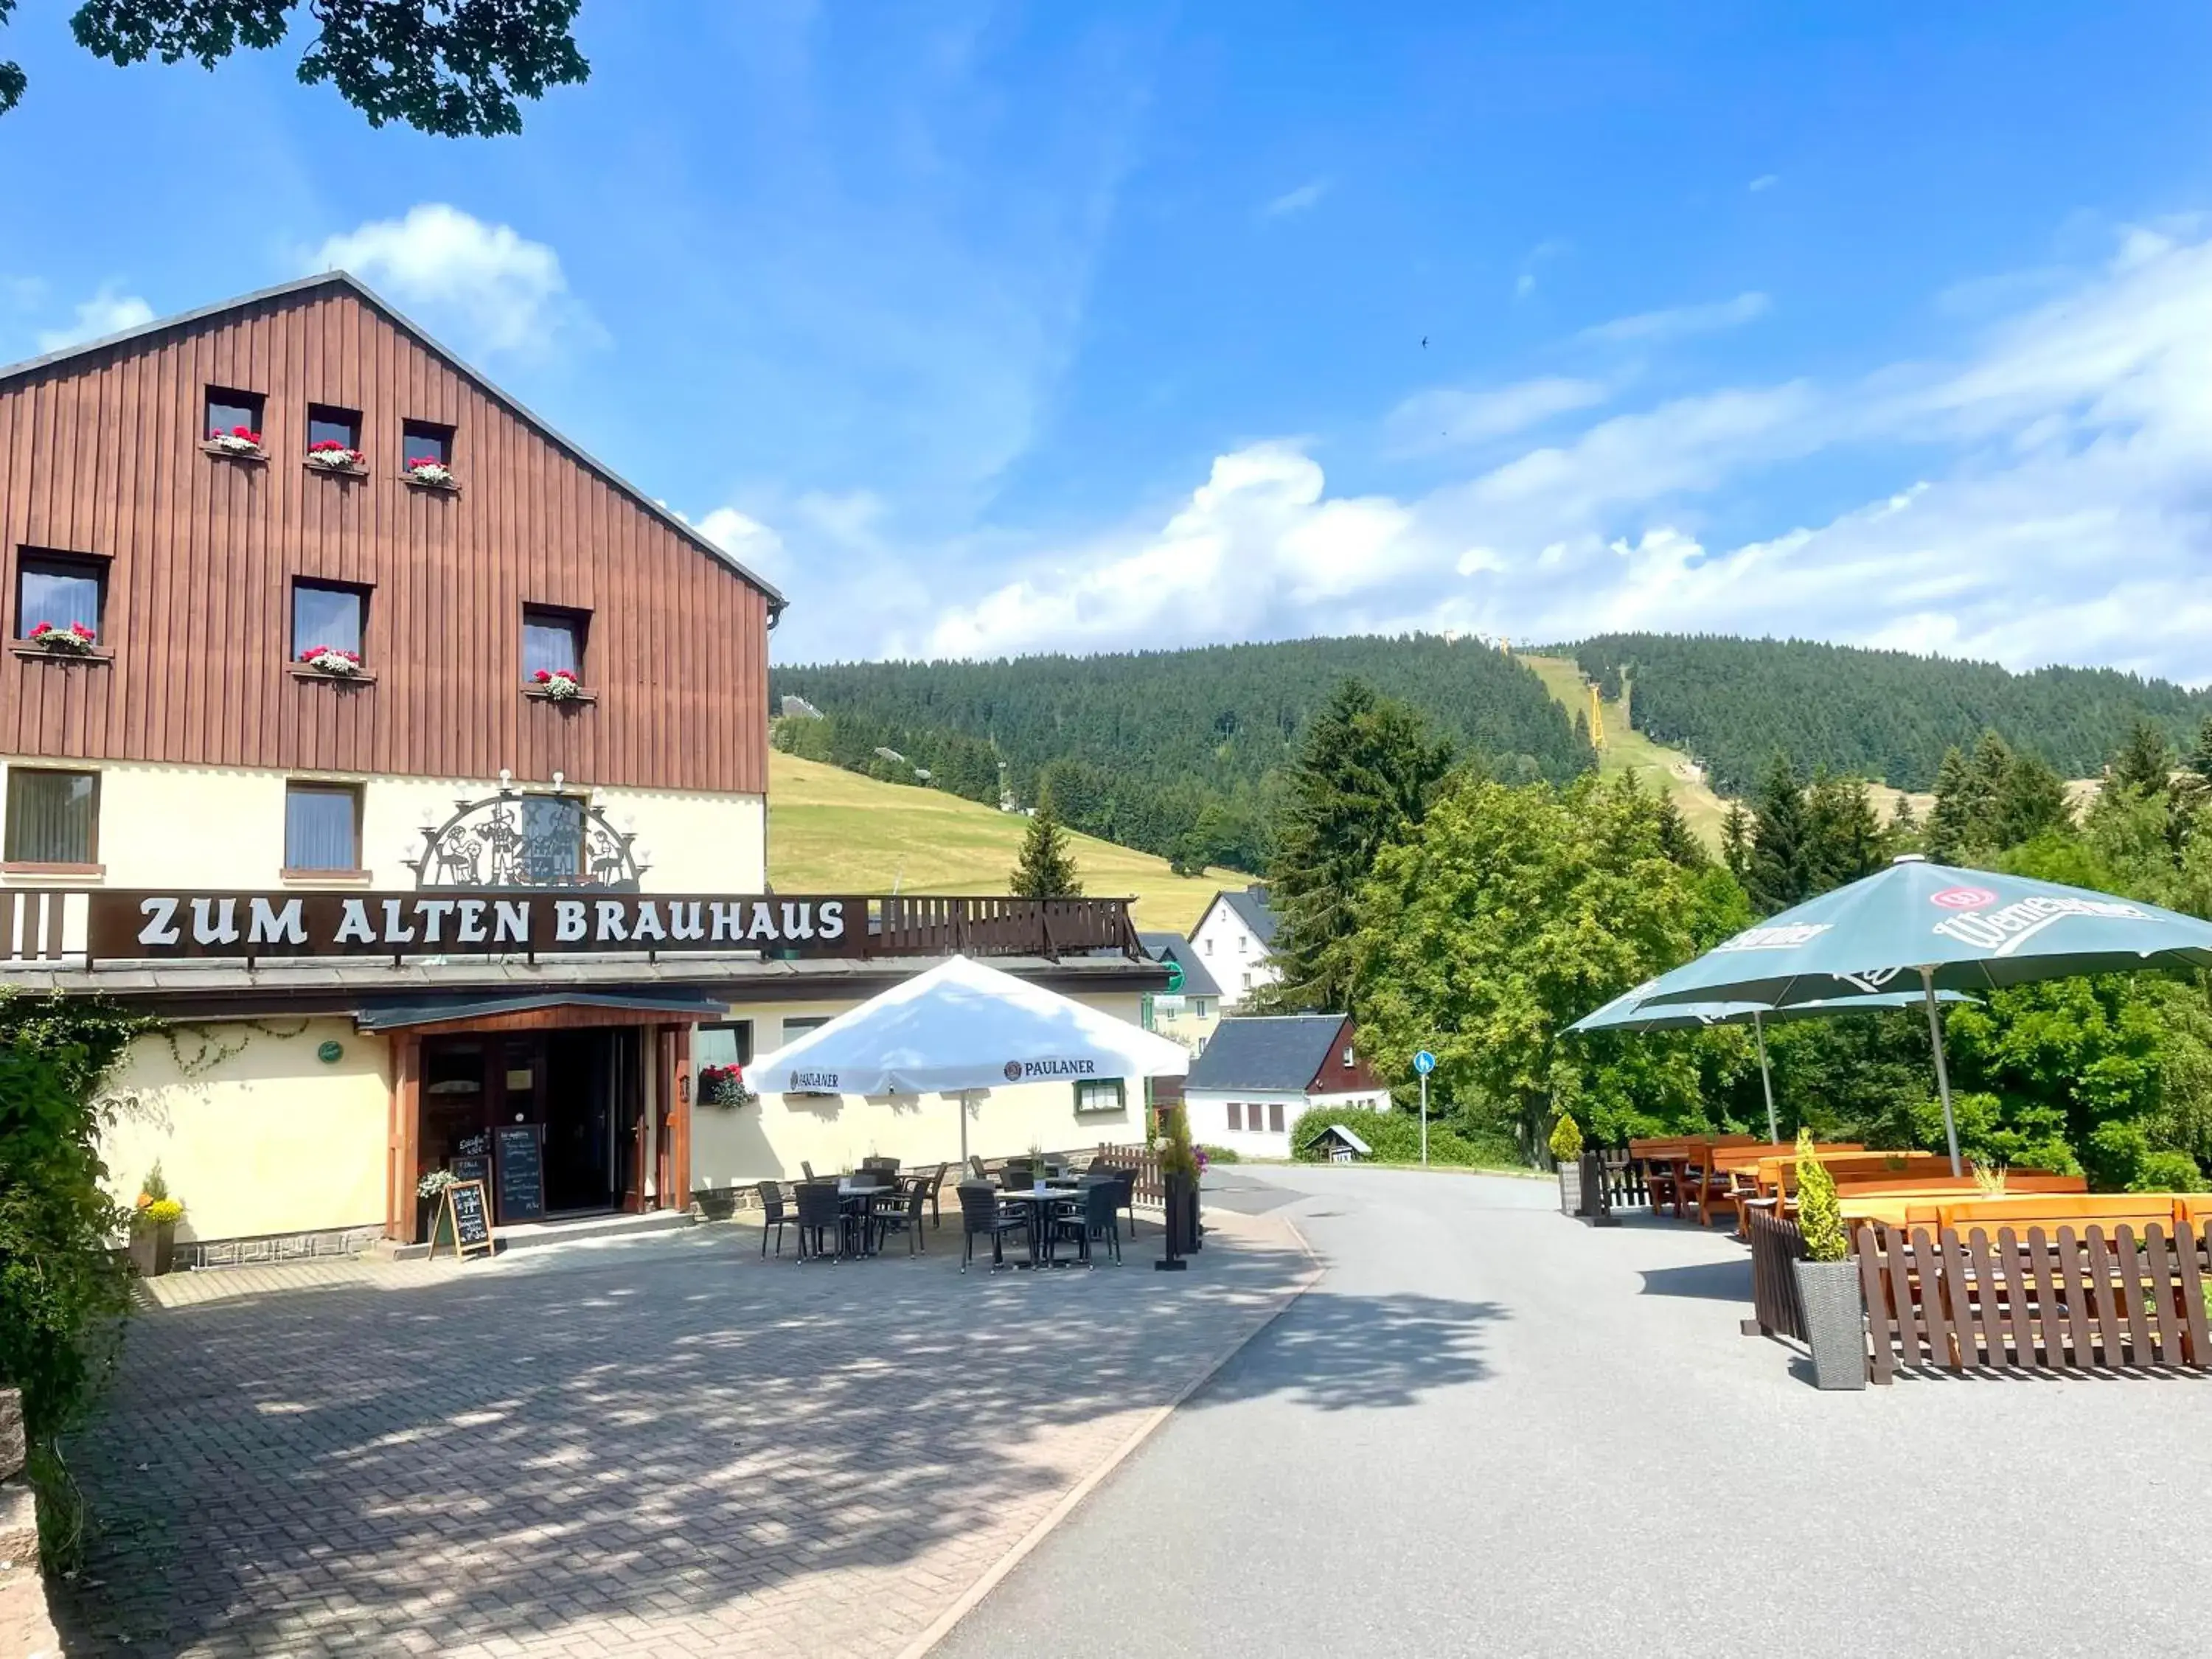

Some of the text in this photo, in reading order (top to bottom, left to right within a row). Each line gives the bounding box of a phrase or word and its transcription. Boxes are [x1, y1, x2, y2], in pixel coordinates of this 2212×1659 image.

[139, 898, 844, 945] ZUM ALTEN BRAUHAUS
[1024, 1059, 1095, 1077] PAULANER
